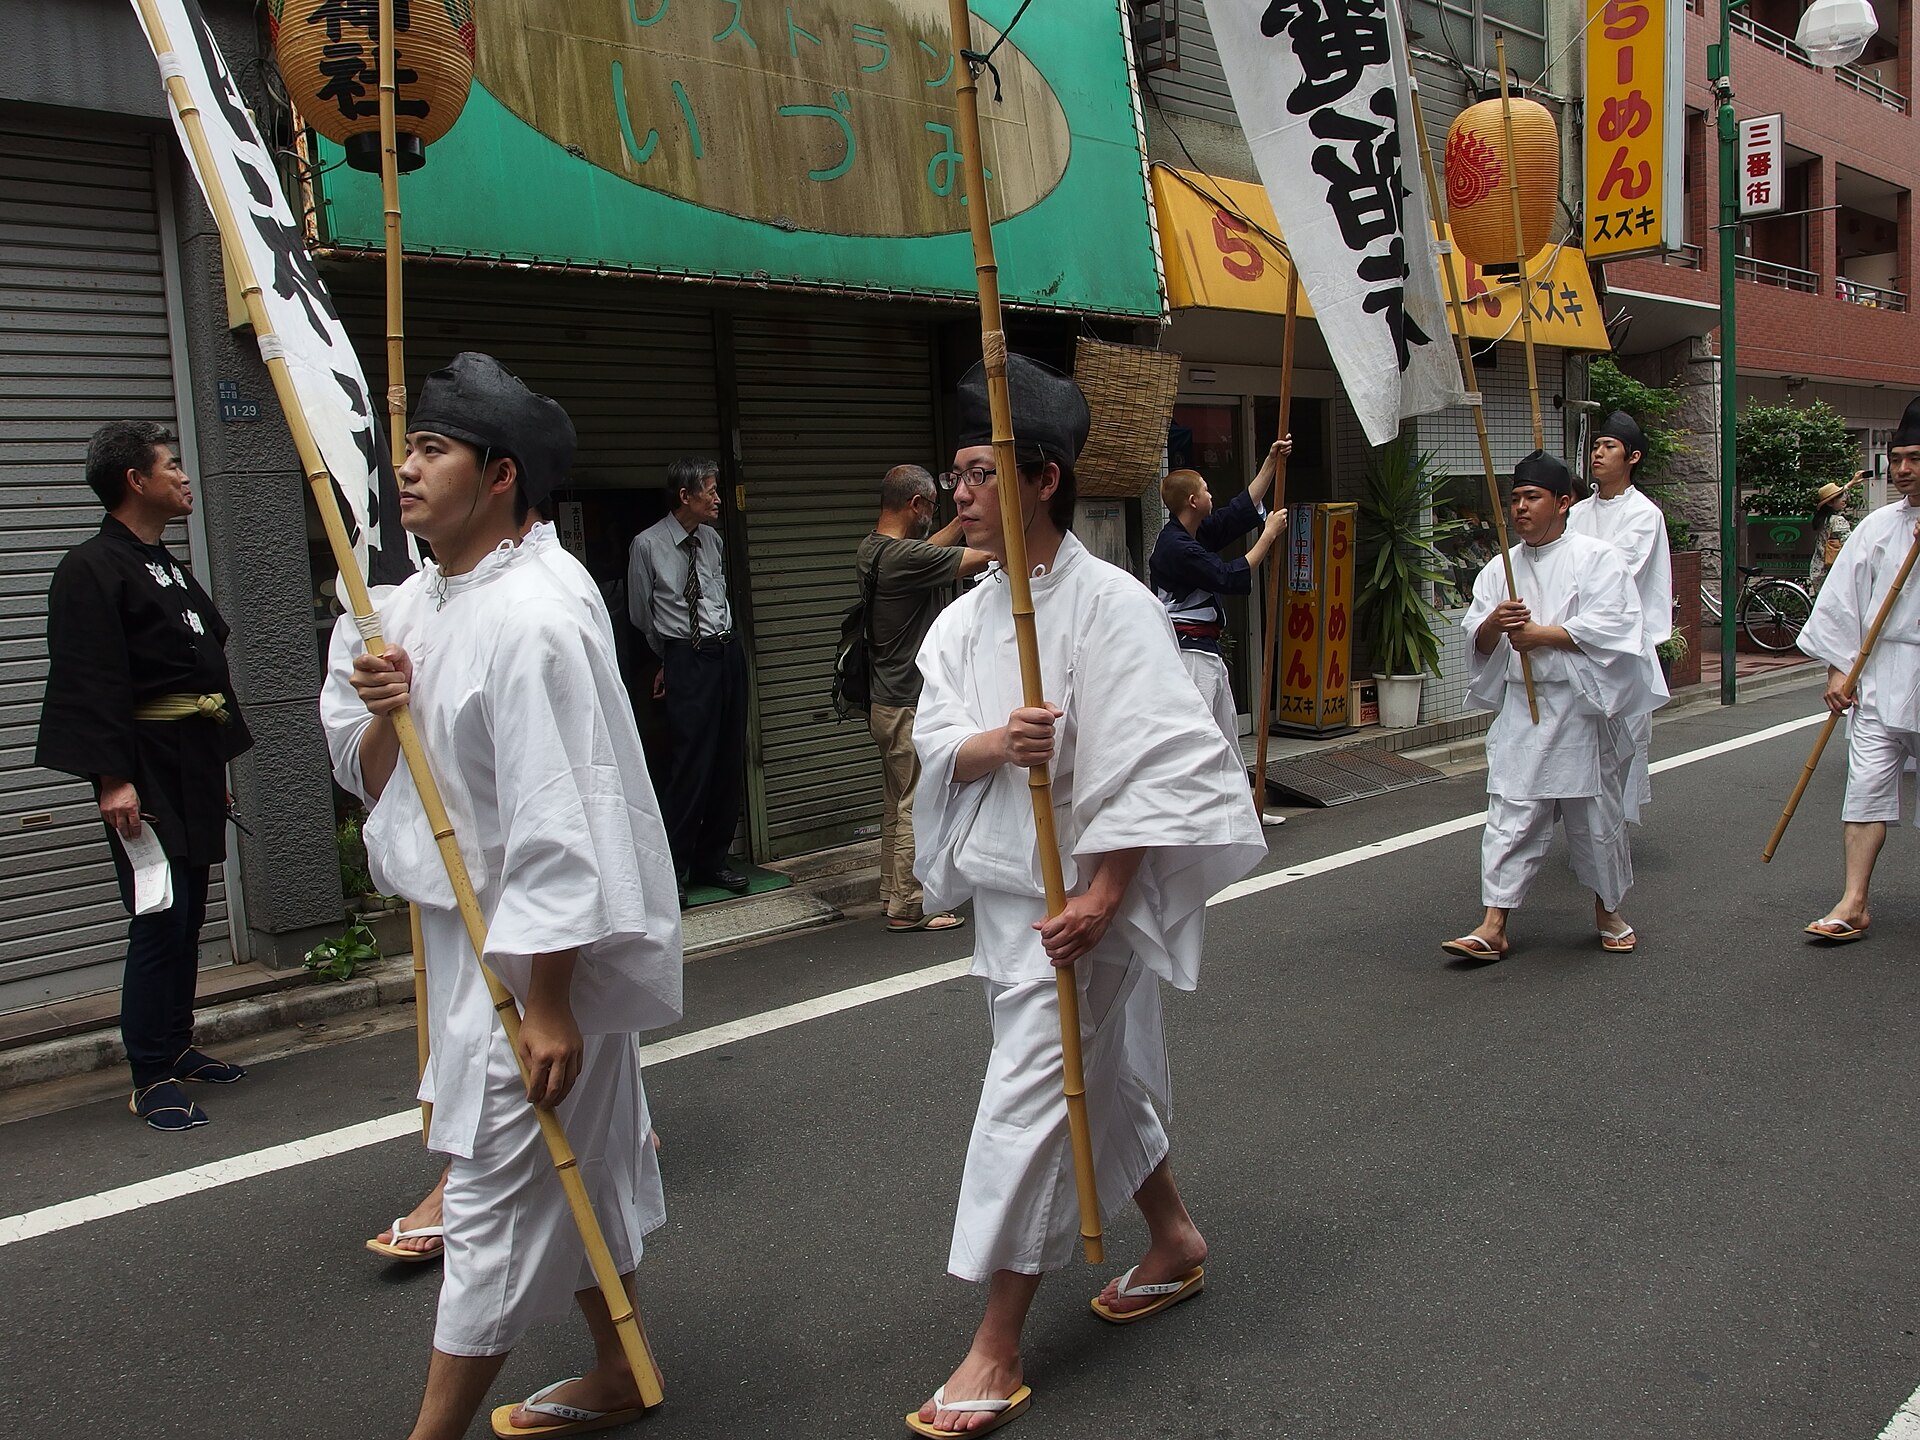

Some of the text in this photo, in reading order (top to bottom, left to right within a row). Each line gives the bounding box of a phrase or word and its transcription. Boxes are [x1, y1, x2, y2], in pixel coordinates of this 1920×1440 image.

[1746, 124, 1771, 206] 三番街
[1593, 206, 1655, 243] スズキ
[224, 405, 257, 416] 11-29
[1327, 520, 1348, 690] らーめん
[1283, 696, 1314, 716] スズキ
[1324, 695, 1346, 716] スズキ
